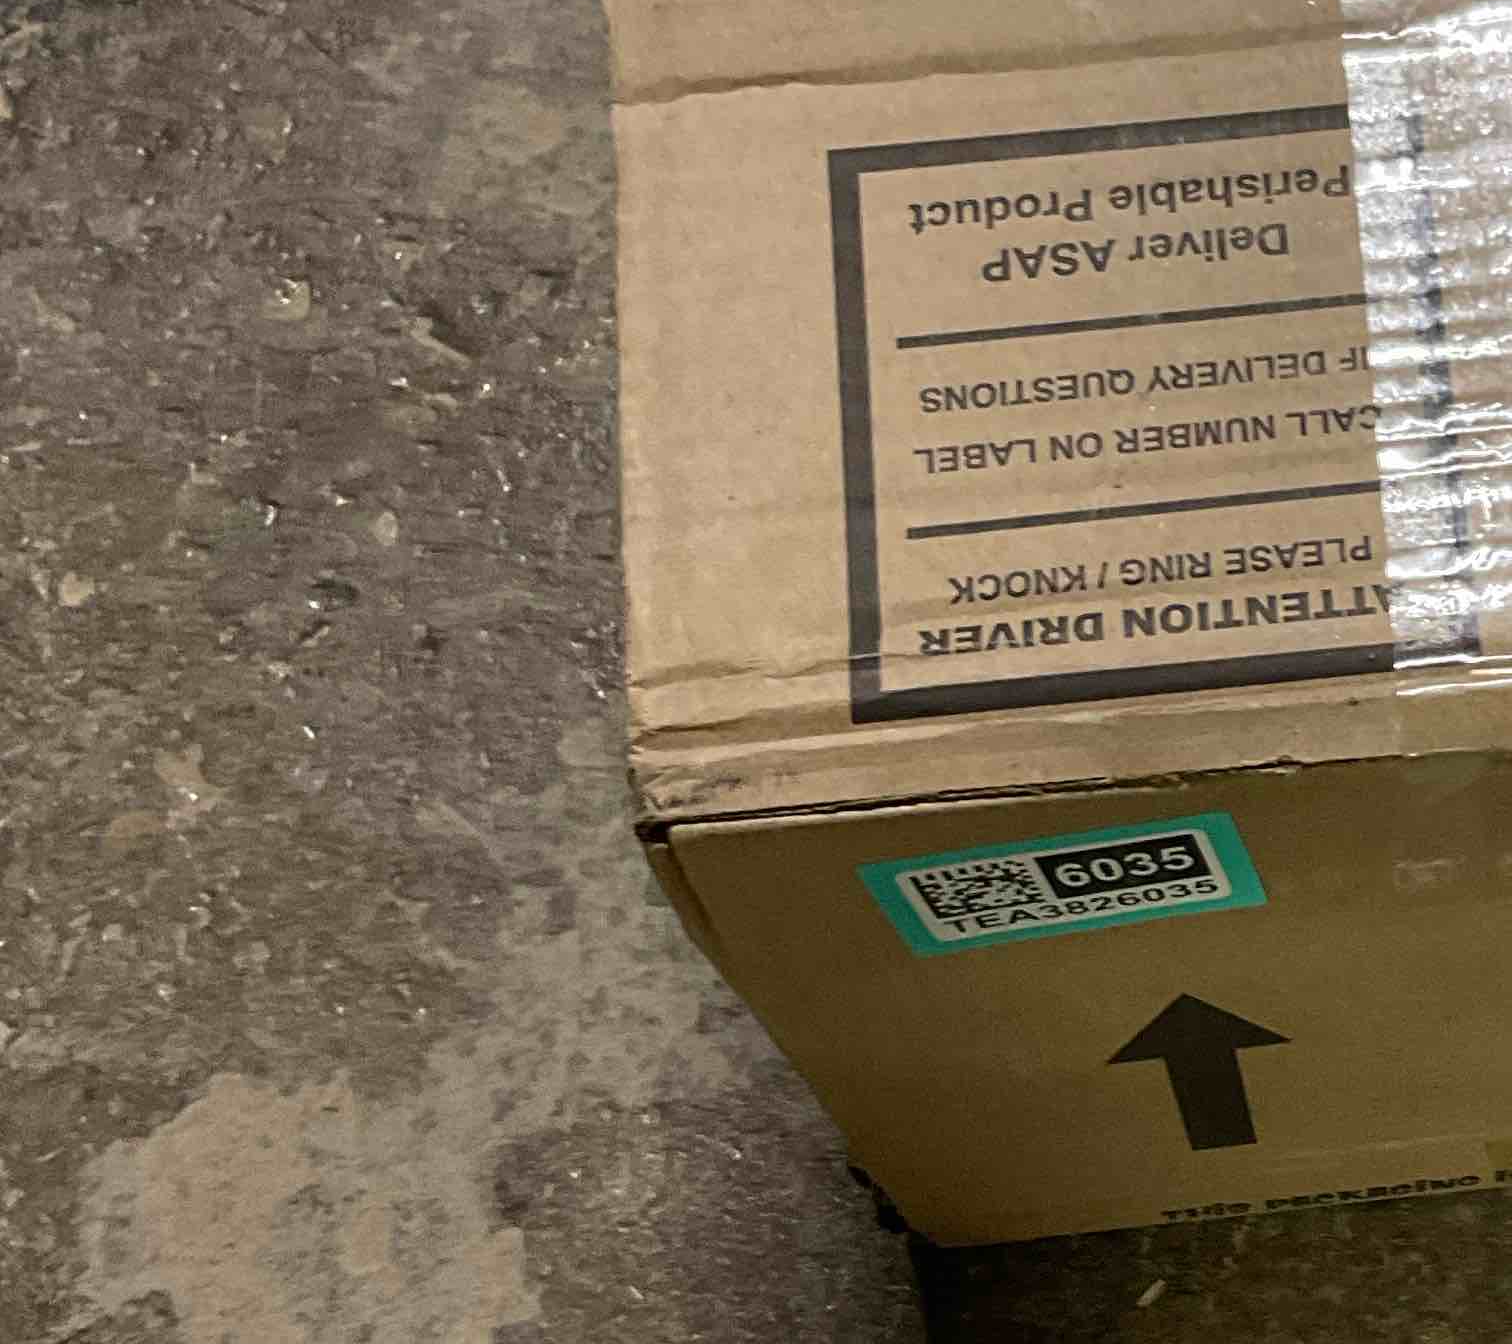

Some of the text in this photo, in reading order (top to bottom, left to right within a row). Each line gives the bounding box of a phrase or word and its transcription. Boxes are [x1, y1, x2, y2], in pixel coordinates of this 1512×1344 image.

[908, 165, 1355, 236] Perishable Product
[980, 222, 1290, 283] Deliver ASAP
[918, 345, 1370, 414] IF DELIVERY QUESTIONS
[913, 404, 1382, 475] CALL NUMBER ON LABEL
[946, 536, 1372, 606] PLEASE RING / KNOCK
[918, 584, 1394, 657] ATTENTION DRIVER
[1055, 846, 1194, 888] 6035
[943, 878, 1219, 933] TEA3826035
